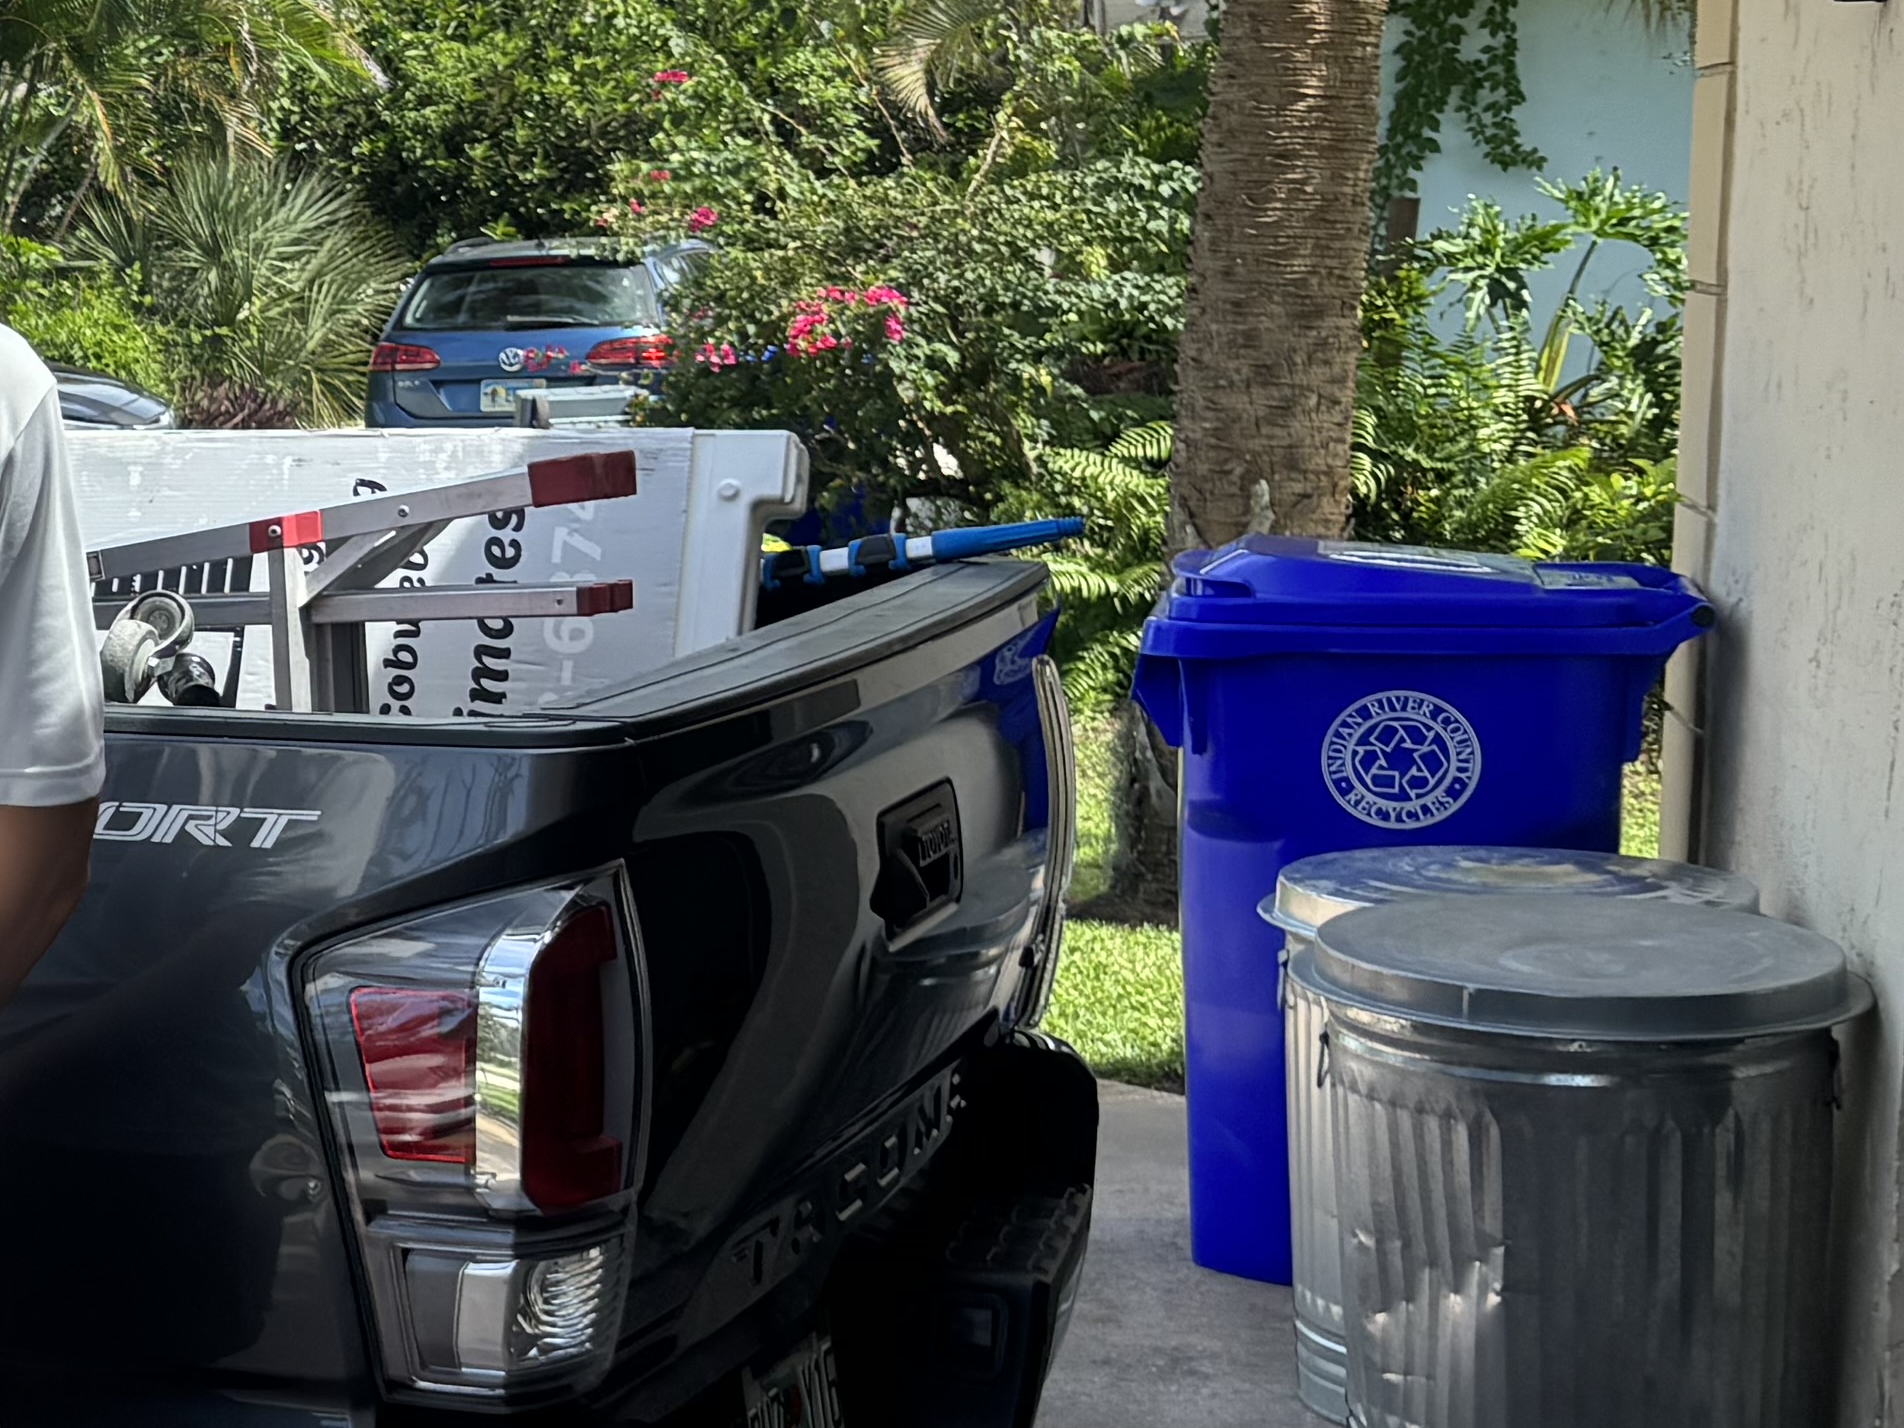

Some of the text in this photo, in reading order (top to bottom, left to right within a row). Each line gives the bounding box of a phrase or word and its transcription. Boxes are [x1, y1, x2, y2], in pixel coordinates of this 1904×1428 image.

[1327, 696, 1475, 783] INDIAN RIVER COUNTY
[1344, 792, 1454, 824] RECYCLES
